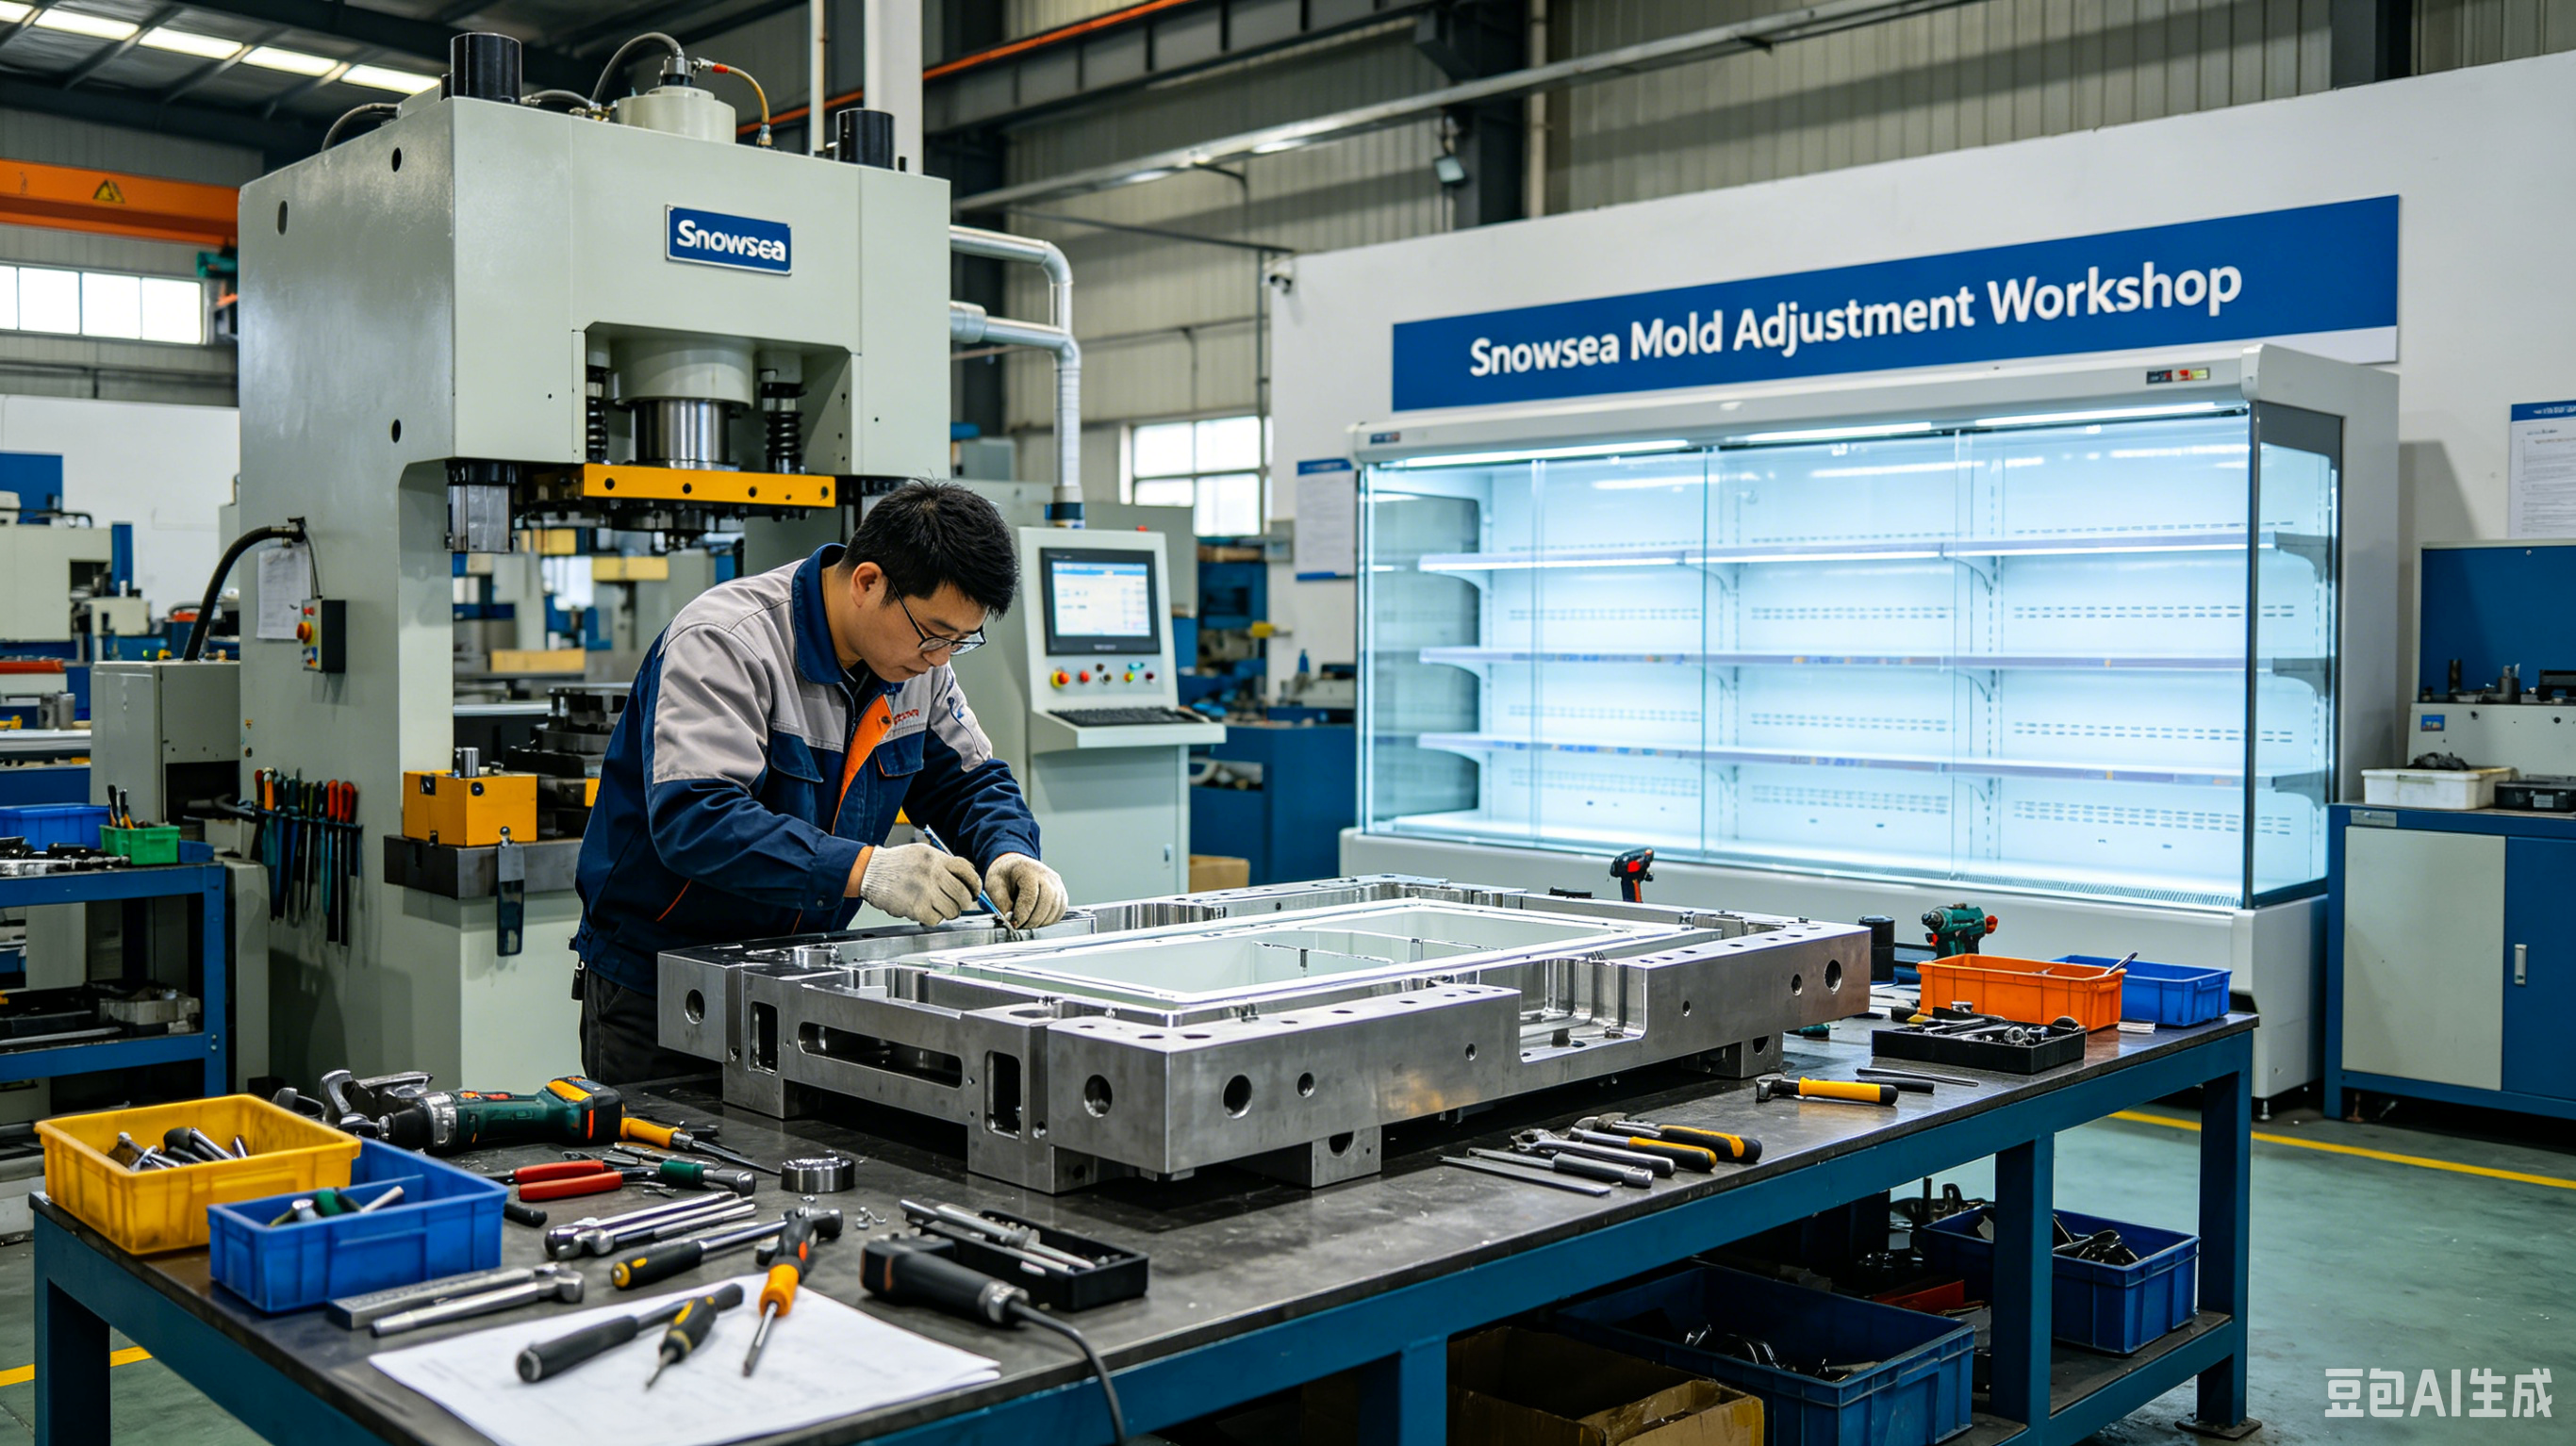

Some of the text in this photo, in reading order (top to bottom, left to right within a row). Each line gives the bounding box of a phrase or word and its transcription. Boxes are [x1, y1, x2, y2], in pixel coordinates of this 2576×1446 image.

[676, 220, 786, 262] Snowsea
[1469, 262, 2243, 378] Snowsea Mold Adjustment Workshop
